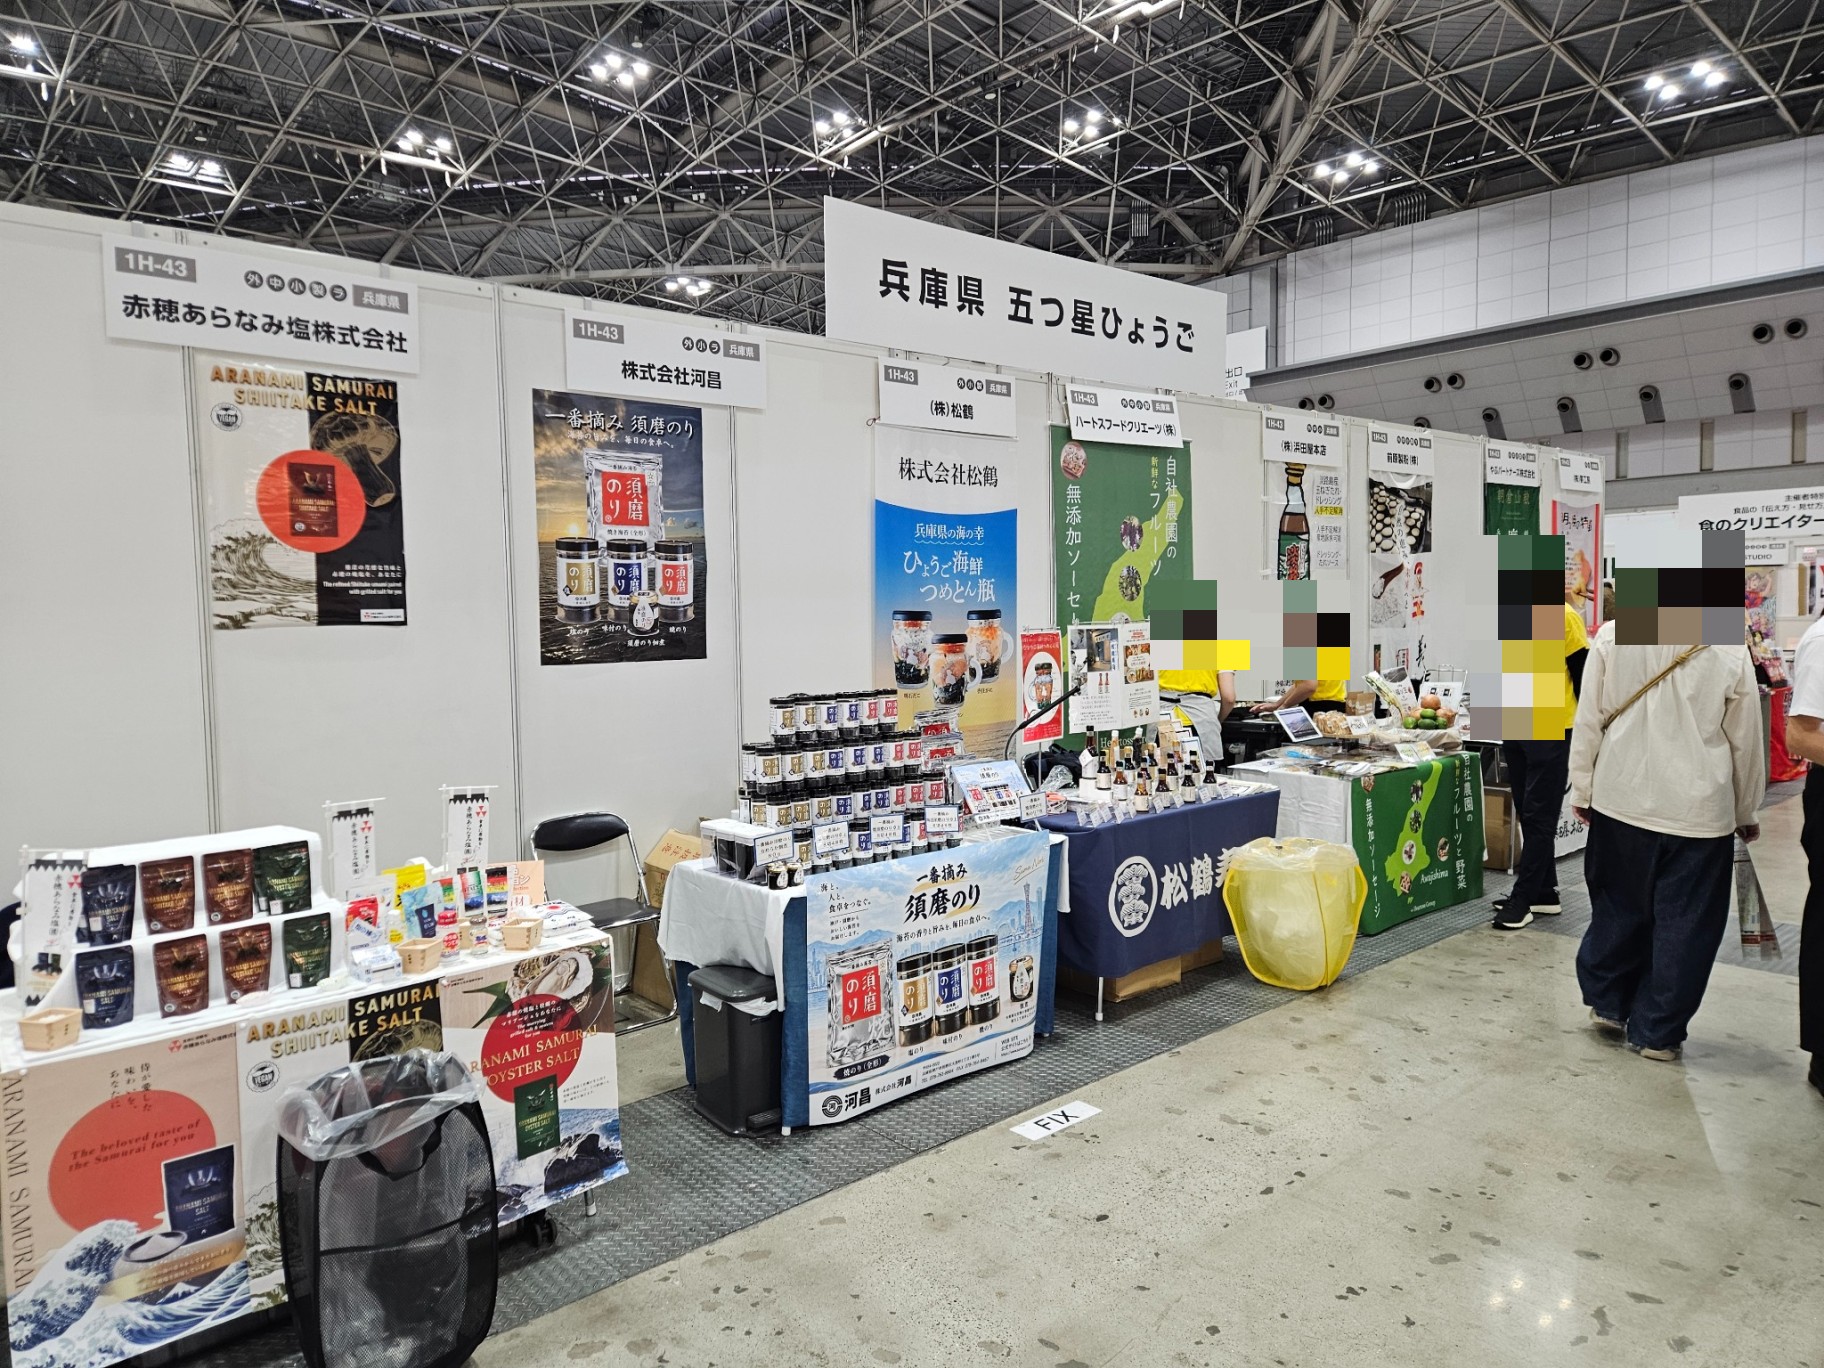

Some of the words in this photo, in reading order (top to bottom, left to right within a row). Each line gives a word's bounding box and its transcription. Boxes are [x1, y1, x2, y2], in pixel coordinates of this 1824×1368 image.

[124, 252, 188, 277] 1H-43
[361, 290, 400, 310] 兵庫県
[878, 257, 985, 317] 兵庫県
[1007, 286, 1196, 353] 五つ星ひょうご
[122, 293, 409, 353] 赤穂あらなみ塩株式会社
[578, 322, 619, 341] 1H-43
[728, 343, 755, 359] 兵庫県
[210, 365, 304, 391] ARANAMI
[311, 376, 394, 400] SAMURAI
[621, 359, 723, 390] 株式会社河昌
[887, 368, 915, 382] 1H-43
[233, 387, 327, 411] SHIITAKE
[334, 396, 378, 416] SALT
[930, 400, 974, 420] (株)松鶴
[1073, 393, 1096, 404] 1H-43
[545, 407, 624, 431] 一番摘み
[630, 414, 694, 440] 須磨のり
[1075, 416, 1177, 437] ハートスフードクリエーツ(株)
[1267, 418, 1284, 430] 1H-43
[1281, 440, 1327, 456] (株)浜田屋本店
[898, 456, 998, 488] 株式会社松鶴
[606, 478, 622, 518] のり
[626, 477, 643, 521] 須磨
[1165, 455, 1178, 559] 自社農園の
[1150, 456, 1162, 577] 新鮮なフルーツ
[914, 522, 985, 541] 兵庫県の海の幸
[903, 549, 984, 578] ひょうご海鮮
[569, 567, 580, 592] のり
[583, 566, 594, 592] 須磨
[615, 566, 627, 592] のり
[664, 567, 674, 592] のり
[675, 566, 686, 592] 須磨
[919, 577, 996, 604] つめとん瓶
[1463, 754, 1474, 822] 自社農園の
[1366, 798, 1381, 918] 無添加ソーセージ
[916, 863, 968, 884] 一番摘み
[820, 883, 839, 892] 海と、
[829, 893, 845, 902] 人と、
[829, 898, 871, 913] 食卓をつなぐ。
[903, 884, 981, 924] 須磨のり
[951, 970, 961, 999] 須磨
[974, 966, 984, 988] のり
[985, 960, 995, 987] 須磨
[846, 978, 859, 1016] のり
[862, 970, 876, 1013] 須磨
[906, 985, 915, 1010] のり
[940, 976, 949, 1000] のり
[246, 1006, 346, 1044] ARANAMI
[270, 1021, 370, 1059] SHIITAKE
[376, 1006, 423, 1033] SALT
[468, 1044, 530, 1075] RANAMI
[536, 1024, 598, 1053] SAMURAI
[254, 1072, 275, 1084] VEGAN
[486, 1060, 543, 1087] OYSTER
[546, 1046, 582, 1068] SALT
[110, 1070, 121, 1109] あなたに
[141, 1062, 152, 1112] 侍が愛した
[844, 1087, 872, 1111] 河昌
[874, 1075, 913, 1096] 株式会社河昌
[1, 1076, 31, 1179] ARANAMI
[1033, 1110, 1080, 1131] FIX
[68, 1159, 90, 1173] the
[95, 1145, 147, 1165] Samurai
[151, 1140, 170, 1152] for
[173, 1133, 196, 1148] you
[72, 1148, 96, 1161] The
[101, 1133, 150, 1150] beloved
[154, 1125, 183, 1138] taste
[187, 1119, 201, 1129] of
[195, 1205, 210, 1216] SALT
[9, 1186, 37, 1289] SAMURAI
